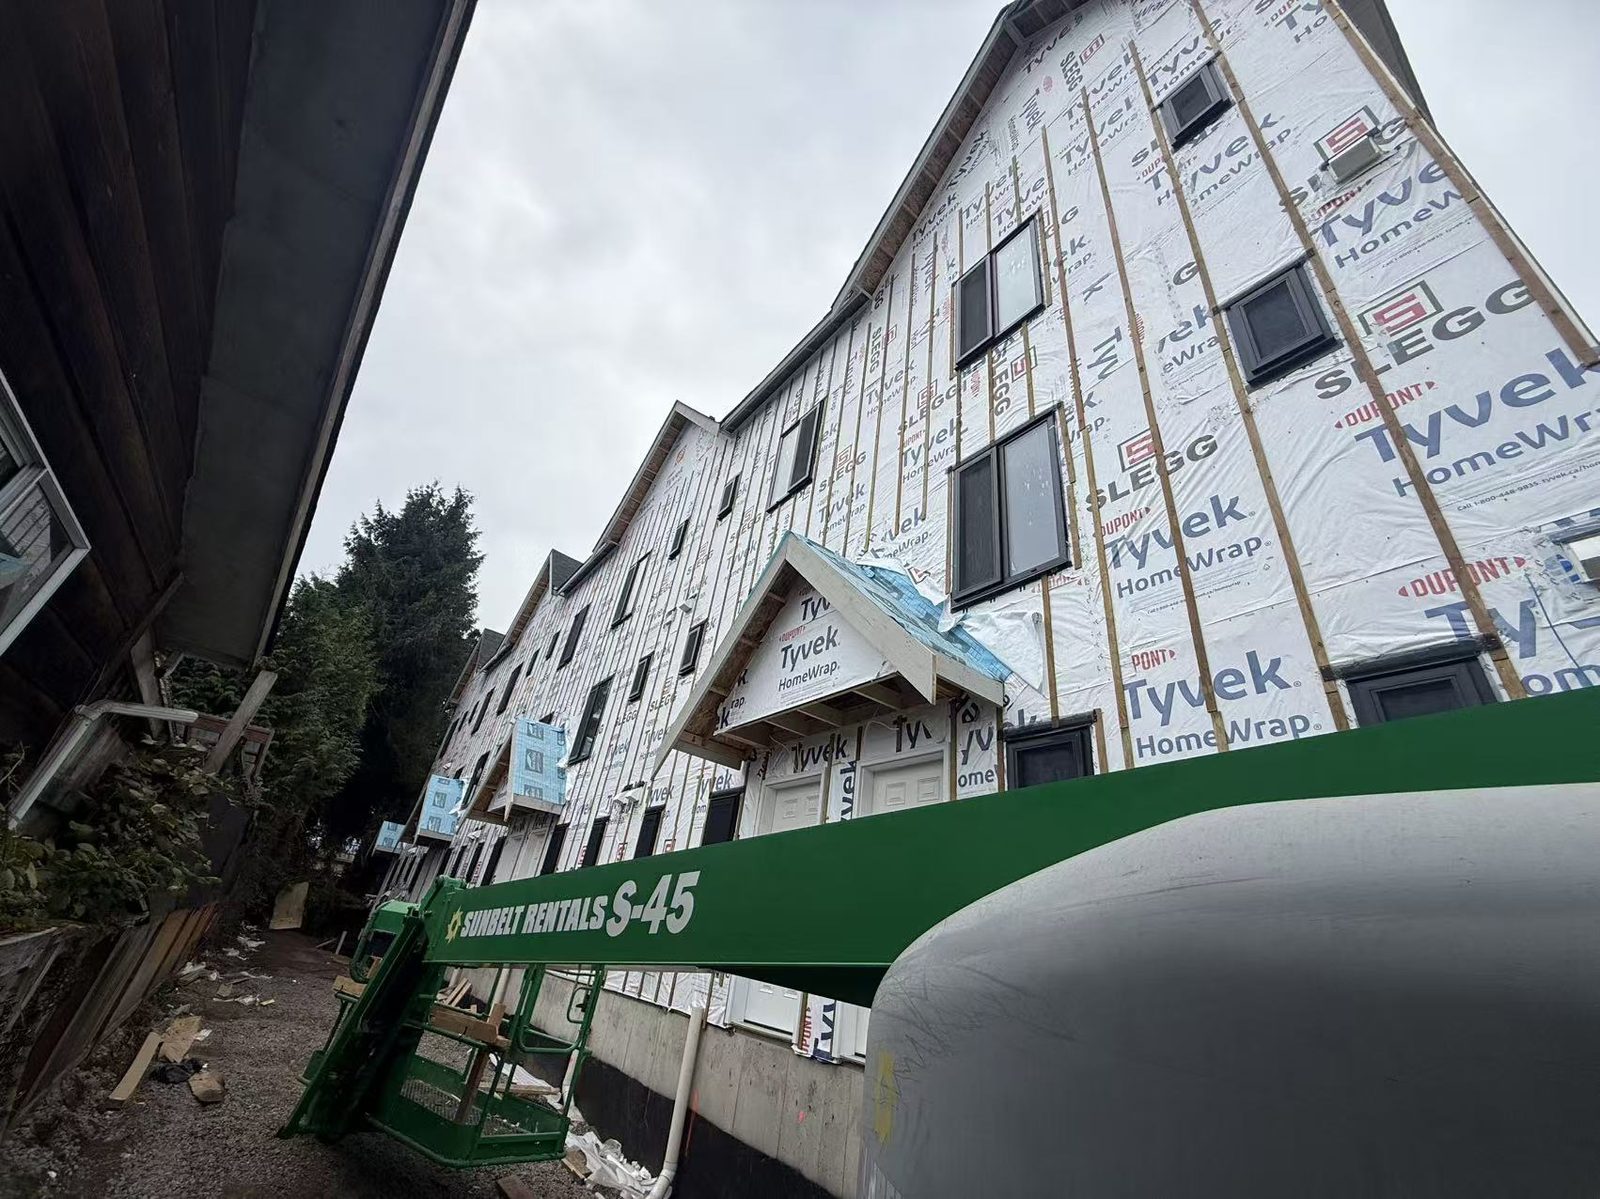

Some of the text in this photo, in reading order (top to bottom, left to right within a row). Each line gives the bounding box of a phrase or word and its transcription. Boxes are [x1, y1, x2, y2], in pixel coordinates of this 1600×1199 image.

[1309, 160, 1448, 248] Tyve
[1335, 190, 1464, 269] HomeW
[1314, 279, 1538, 400] SLEGG
[1345, 383, 1424, 427] DUPONT
[1086, 434, 1219, 512] SLEGG
[1392, 410, 1600, 498] HomeWr
[1103, 494, 1248, 570] Tyvek
[1116, 535, 1263, 599] HomeWrap
[1411, 556, 1511, 598] DUPONT
[781, 626, 804, 643] DUPONT
[801, 596, 831, 622] Tyv
[778, 660, 838, 693] HomeWrap
[780, 625, 840, 673] Tyvek
[1131, 648, 1167, 673] PONT
[1123, 650, 1292, 727] Tyvek
[1136, 714, 1310, 759] HomeWrap
[840, 761, 857, 821] vek
[460, 870, 701, 938] SUNBELT RENTALS S-45
